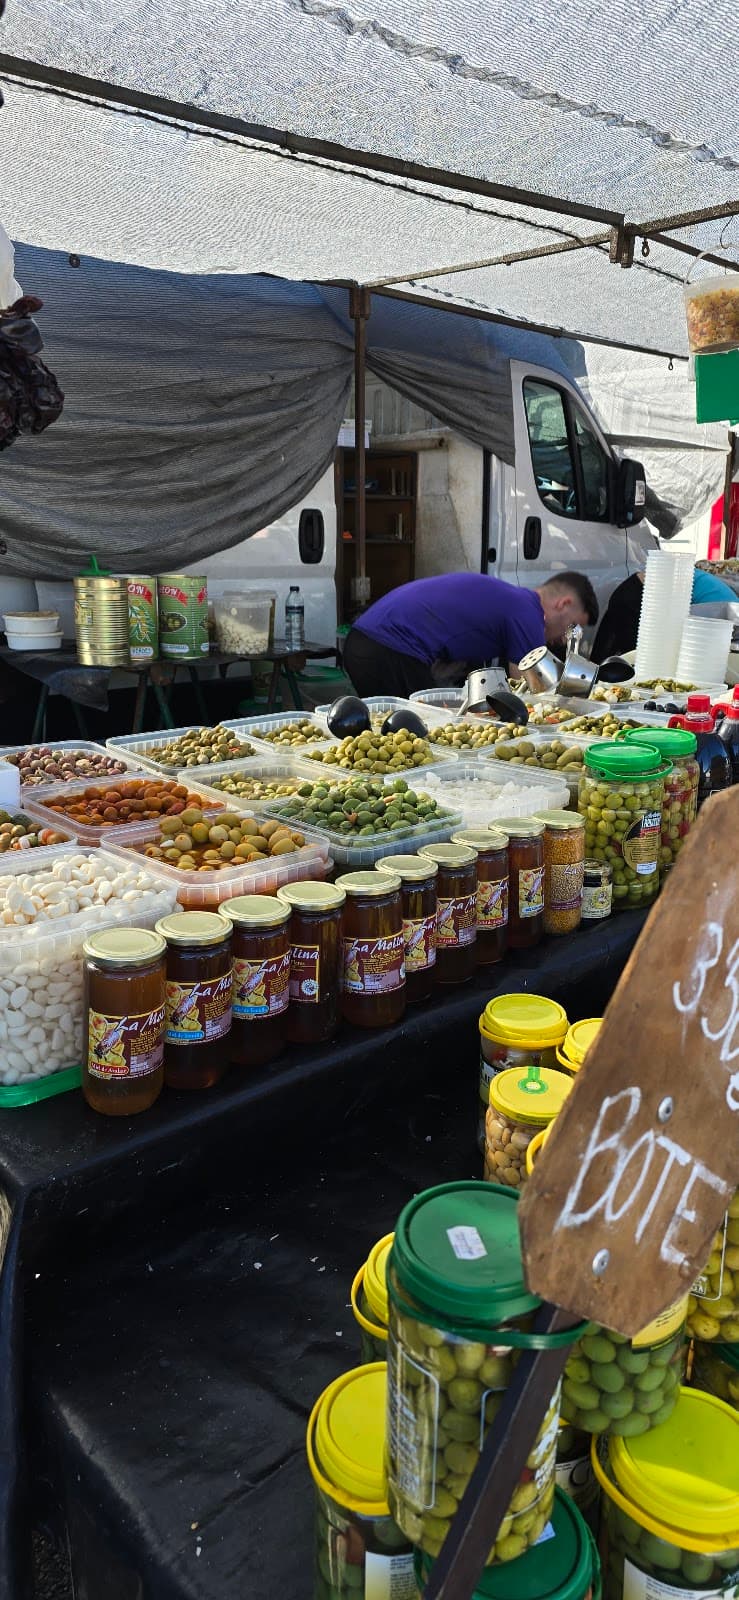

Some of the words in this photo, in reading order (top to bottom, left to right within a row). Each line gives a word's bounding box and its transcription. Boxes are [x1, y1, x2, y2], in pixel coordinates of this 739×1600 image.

[127, 584, 144, 595] ON
[291, 947, 320, 960] lina
[351, 939, 369, 953] La
[370, 936, 404, 955] Molin
[256, 959, 277, 975] La
[188, 982, 211, 999] La
[114, 1016, 138, 1033] La
[553, 1085, 733, 1267] BOTE
